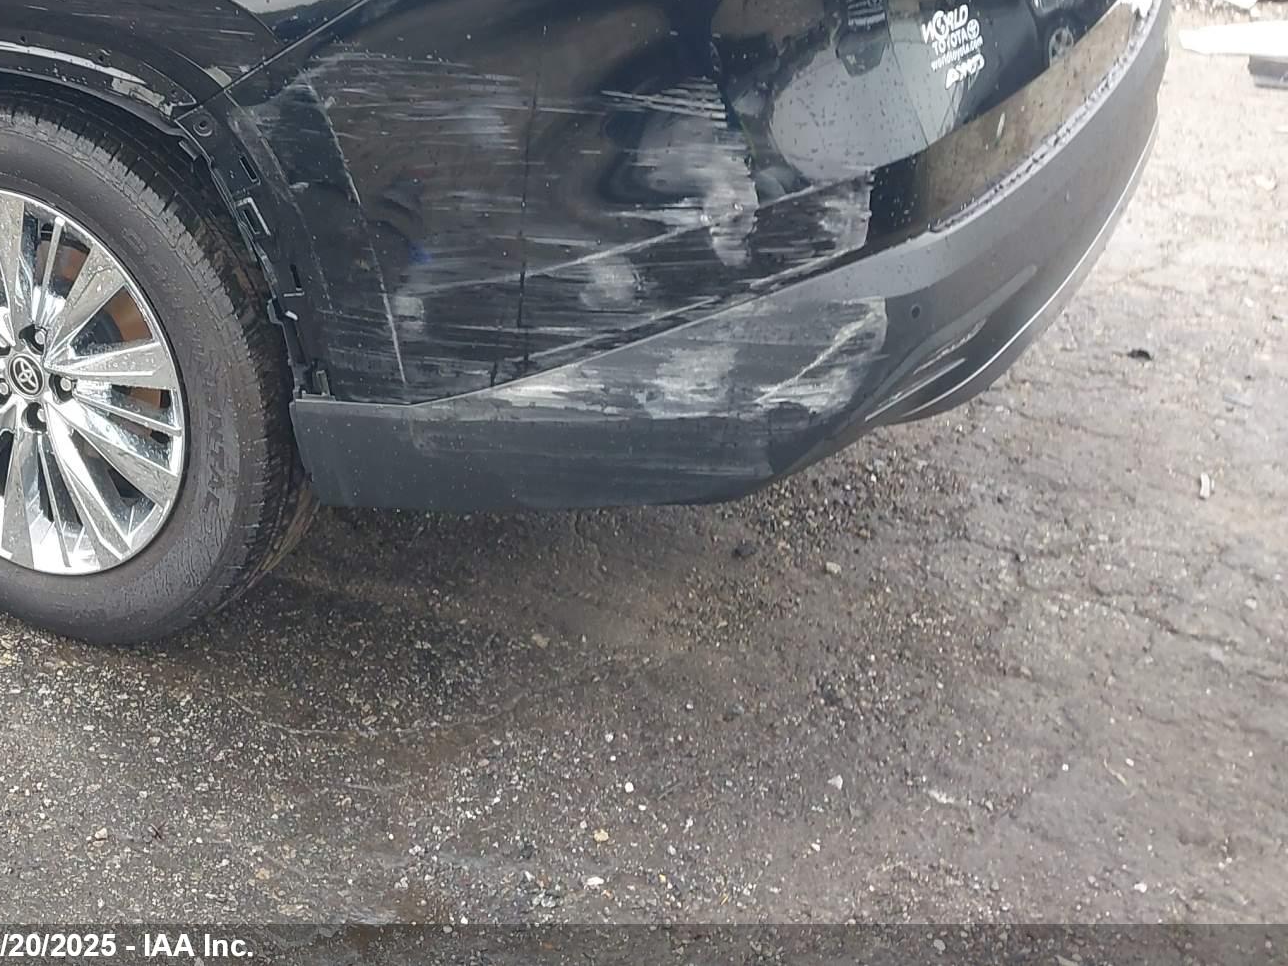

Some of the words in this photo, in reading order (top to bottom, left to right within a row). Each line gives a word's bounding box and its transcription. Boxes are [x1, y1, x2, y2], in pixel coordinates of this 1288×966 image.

[921, 4, 969, 44] WORLD
[931, 27, 968, 56] TOYOTA
[930, 35, 984, 71] worldtoyota.com
